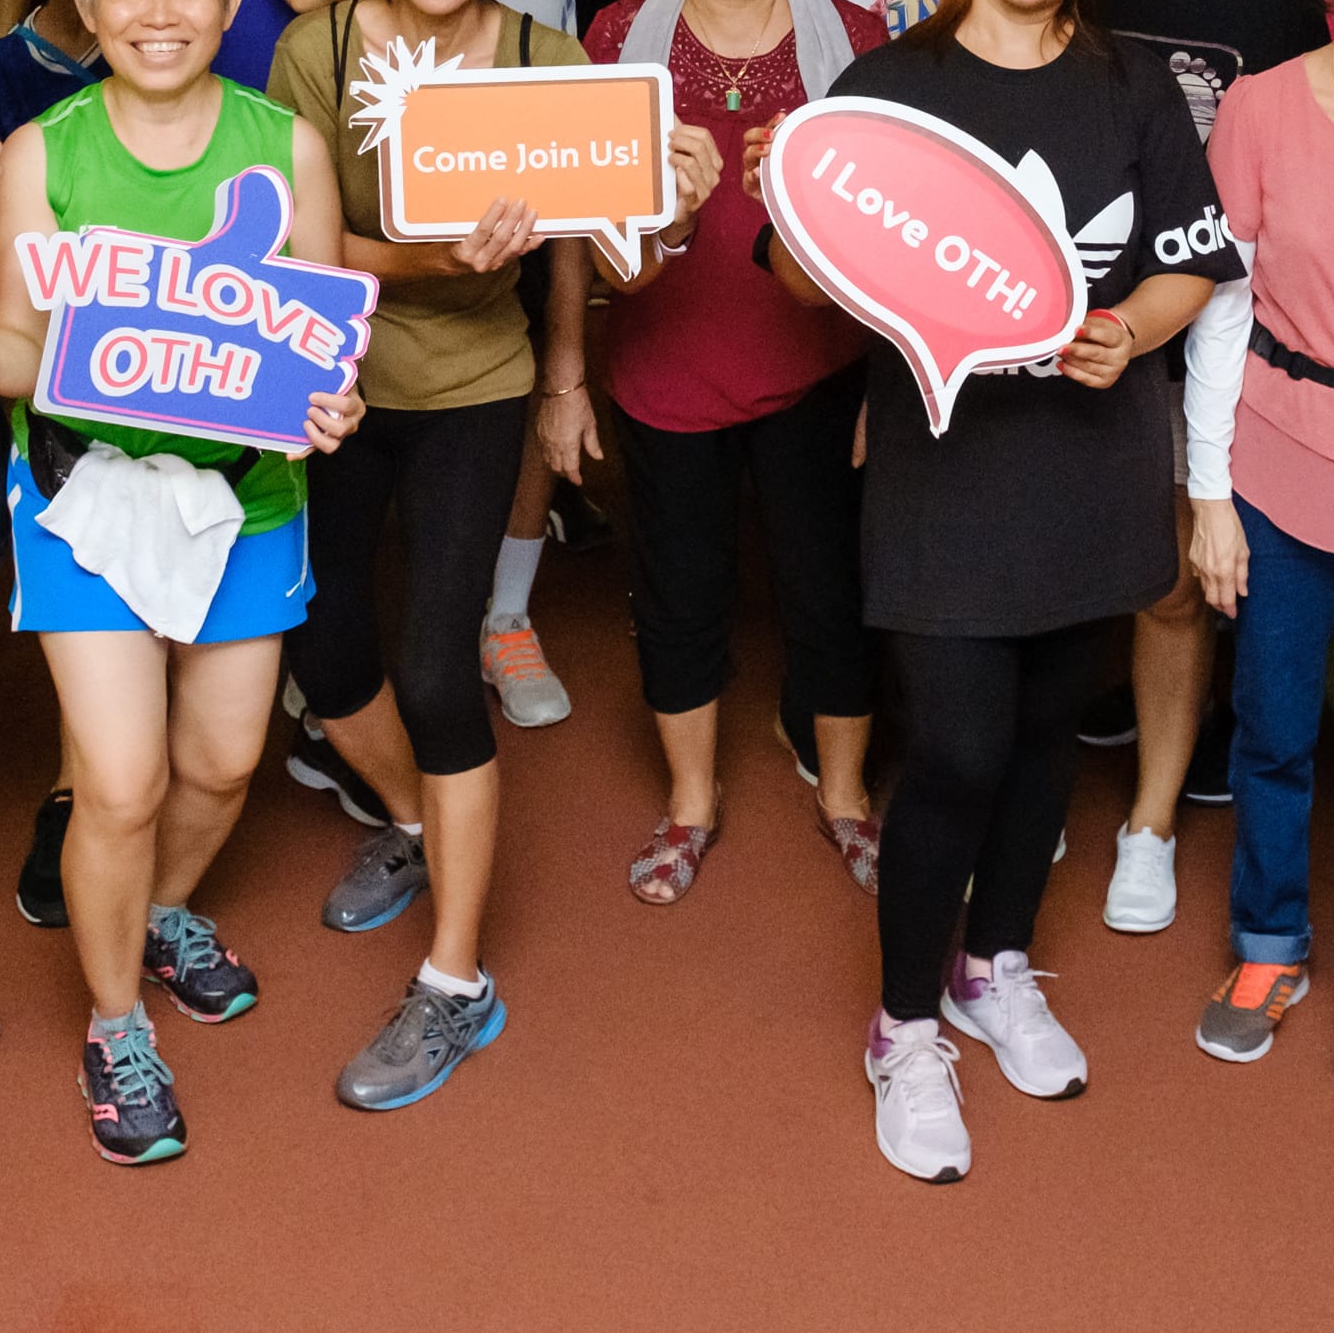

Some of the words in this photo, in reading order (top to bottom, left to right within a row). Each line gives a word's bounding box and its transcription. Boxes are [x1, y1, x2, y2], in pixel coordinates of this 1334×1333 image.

[412, 145, 508, 174] Come
[515, 141, 580, 174] Join
[589, 138, 640, 167] Us!
[812, 147, 838, 180] I
[830, 161, 930, 249] Love
[933, 234, 1038, 321] OTH!
[26, 242, 144, 300] WE
[166, 255, 339, 363] LOVE
[98, 334, 253, 394] OTH!
